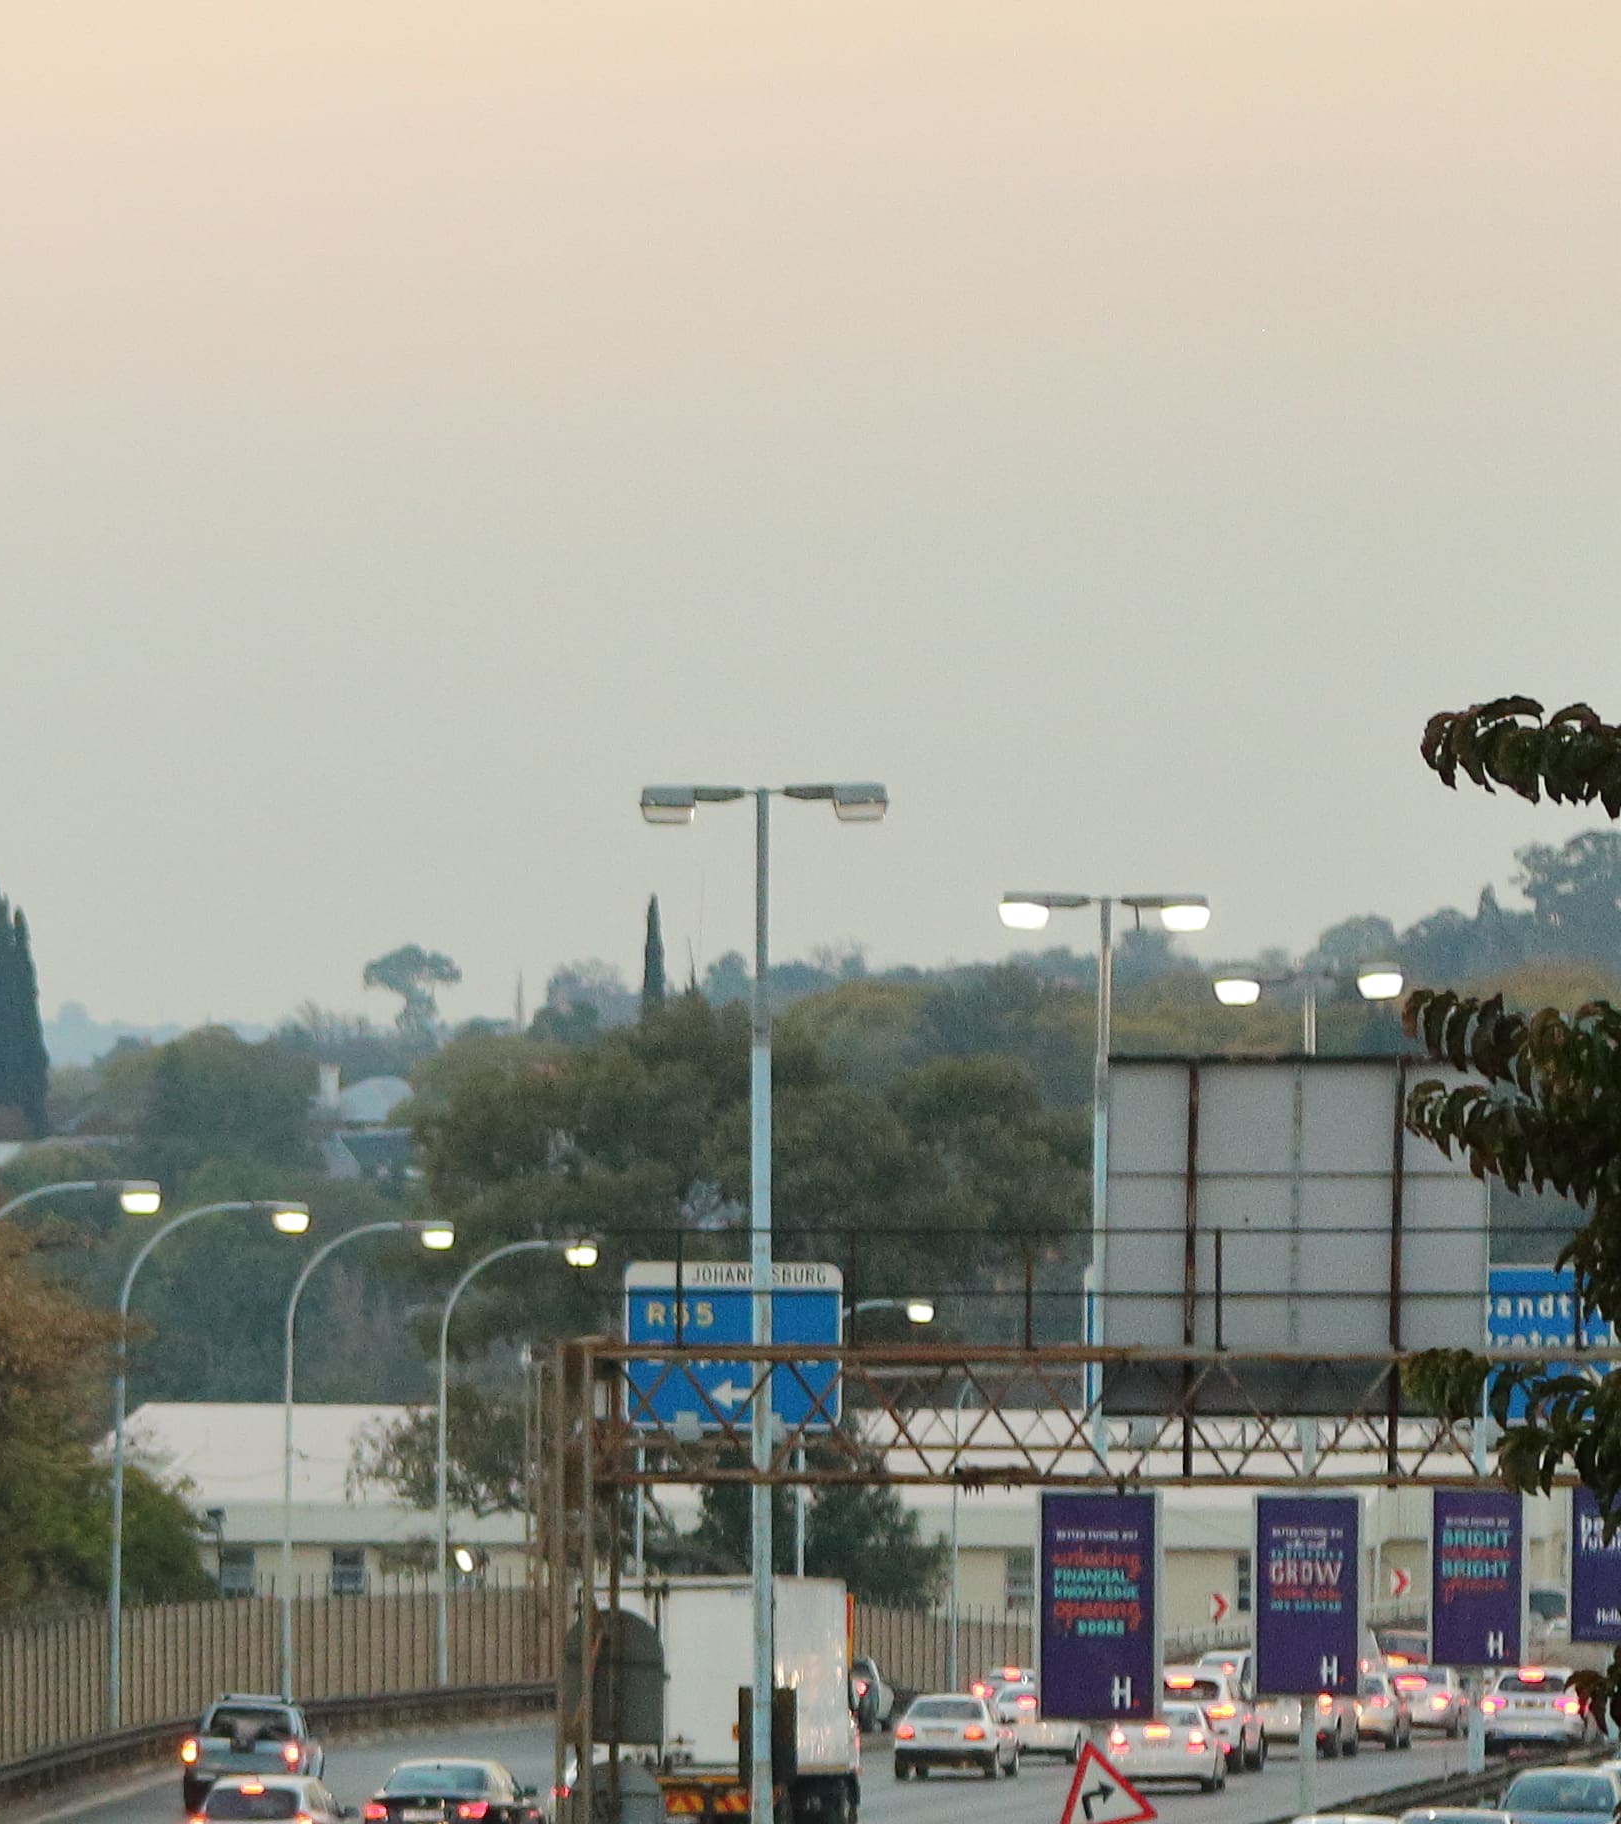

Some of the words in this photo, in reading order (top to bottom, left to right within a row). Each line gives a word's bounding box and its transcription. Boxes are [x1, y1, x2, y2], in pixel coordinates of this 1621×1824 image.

[692, 1265, 827, 1284] JOHANSBURG
[1442, 1528, 1511, 1548] BRIGHT
[1054, 1567, 1127, 1583] FINANCIAL
[1270, 1560, 1343, 1585] GROW
[1442, 1560, 1510, 1578] BRIGHT
[1054, 1583, 1139, 1599] KNOWLEDGE
